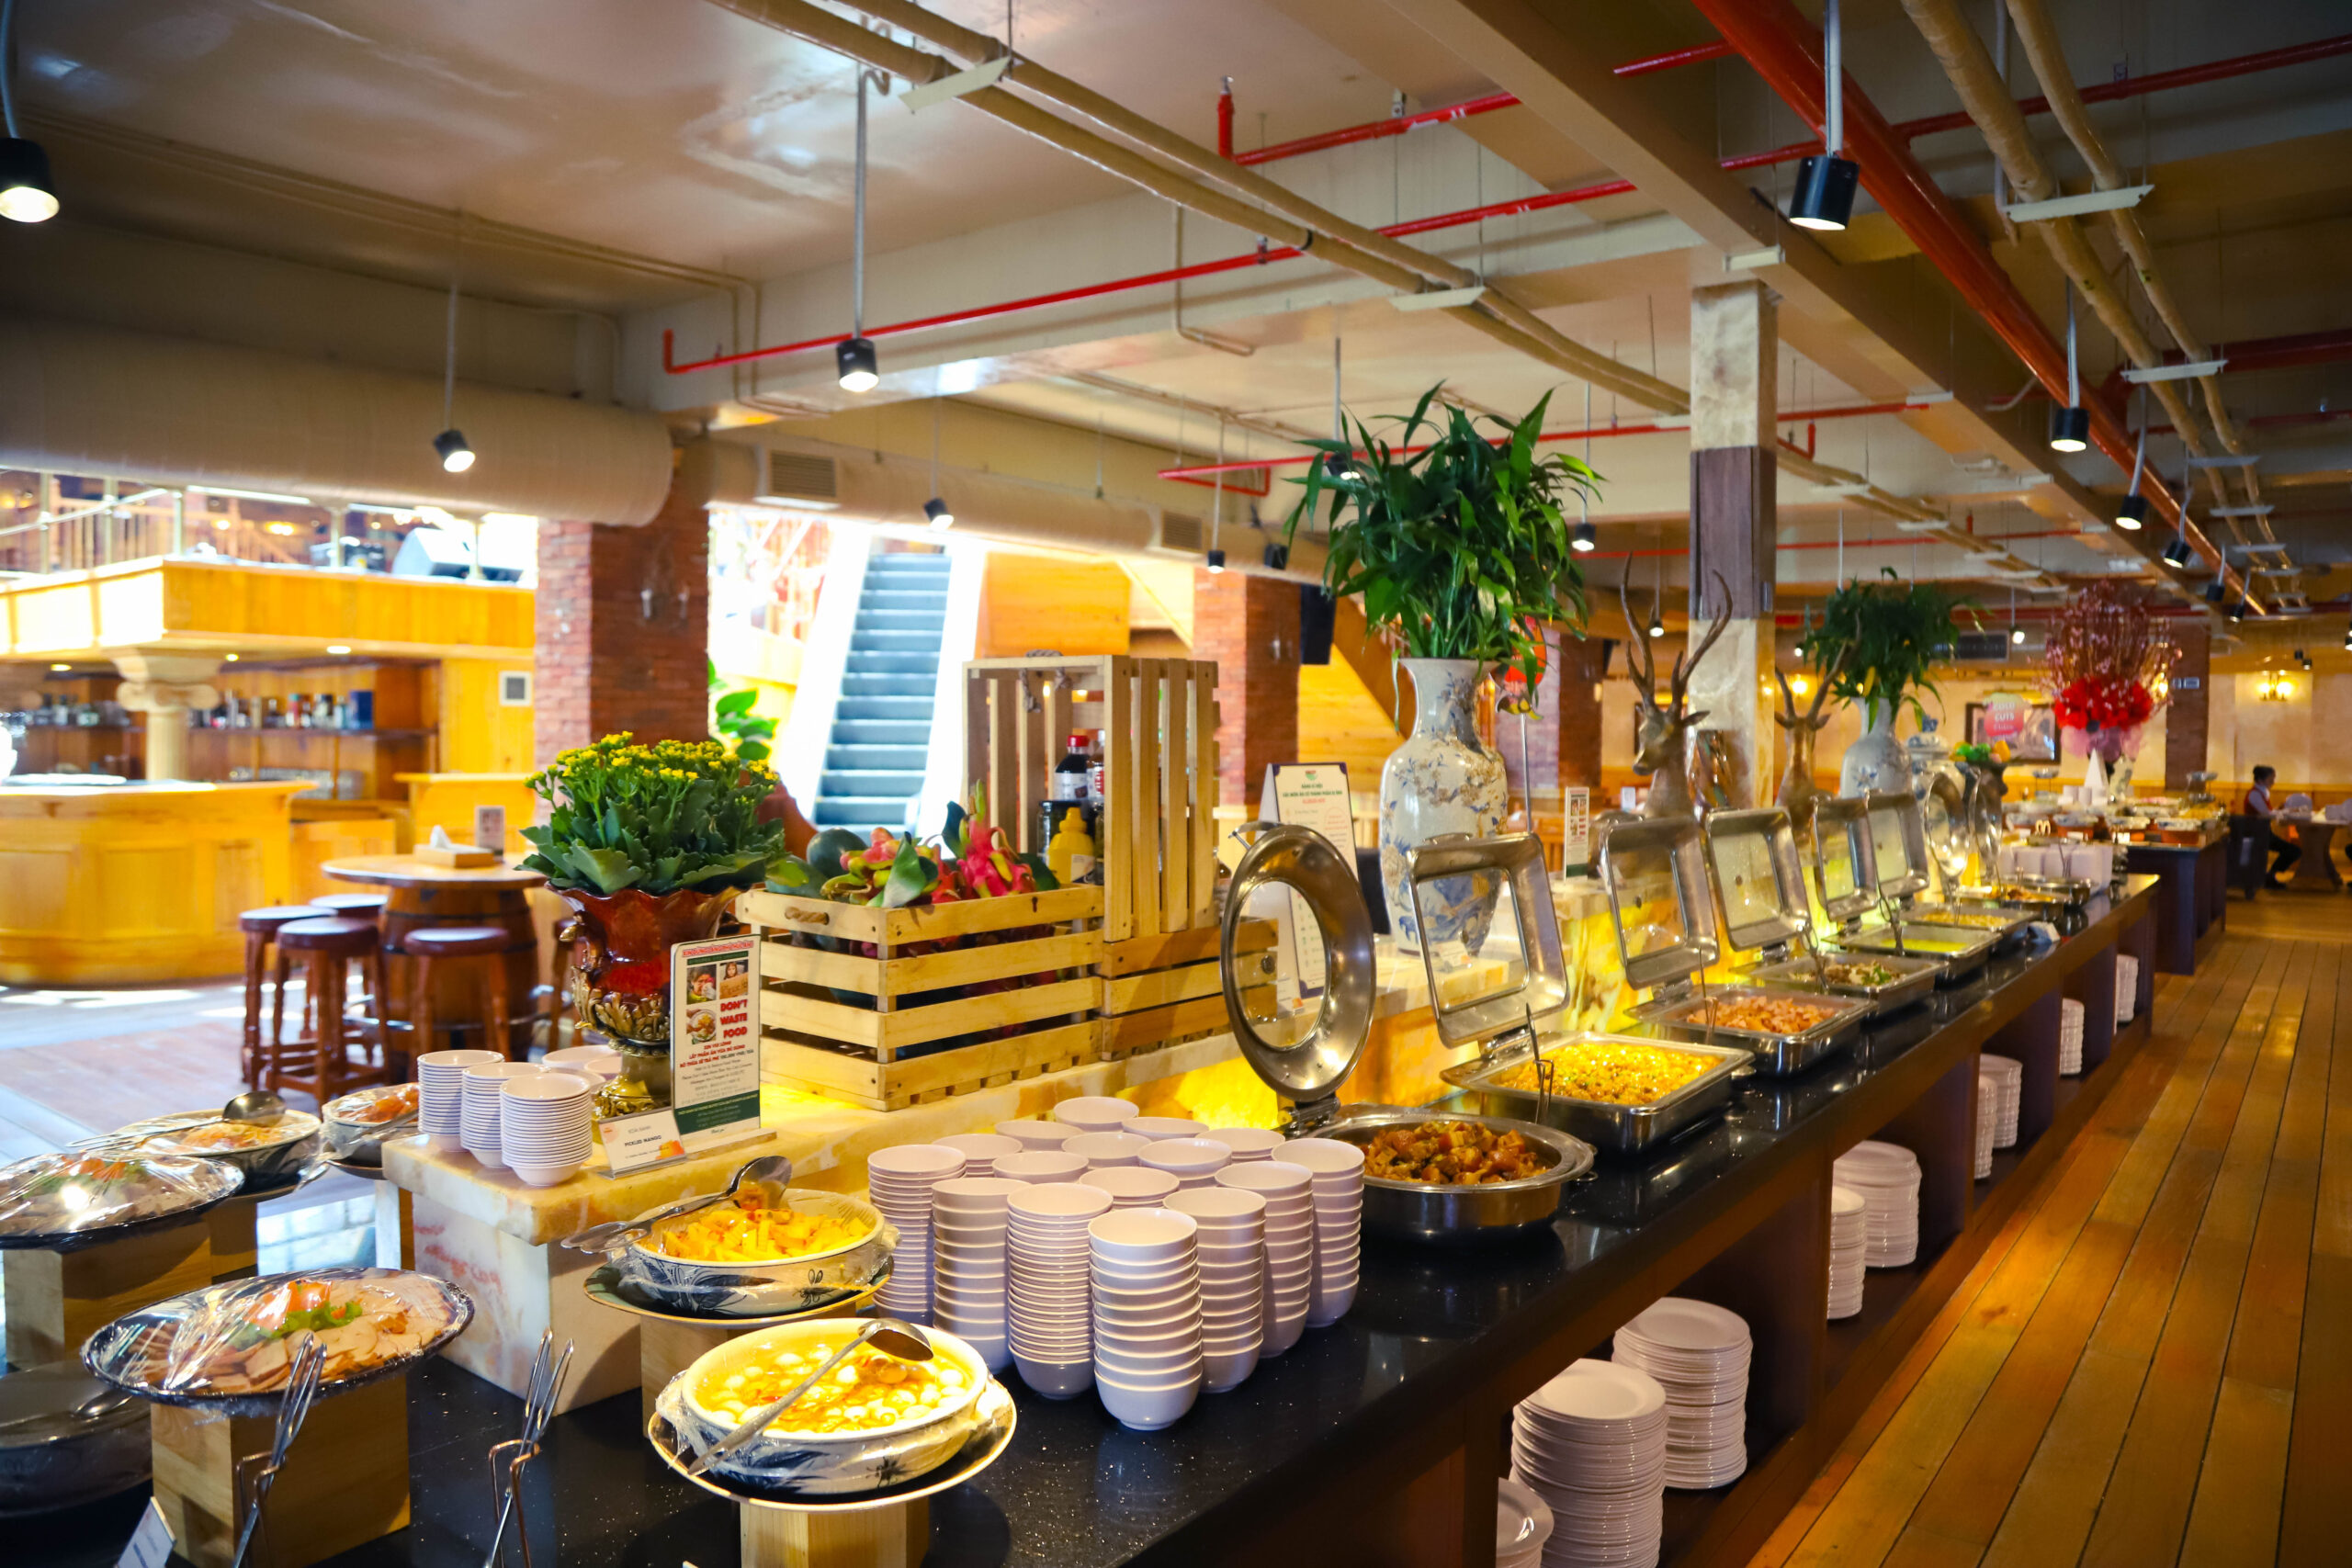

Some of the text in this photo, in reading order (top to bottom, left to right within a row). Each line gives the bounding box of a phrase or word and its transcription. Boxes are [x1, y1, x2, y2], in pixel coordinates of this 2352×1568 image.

[1995, 712, 2015, 721] CUTS
[719, 998, 748, 1012] DON'T
[719, 1012, 748, 1025] WASTE
[723, 1026, 748, 1039] FOOD
[643, 1134, 662, 1143] MANGO
